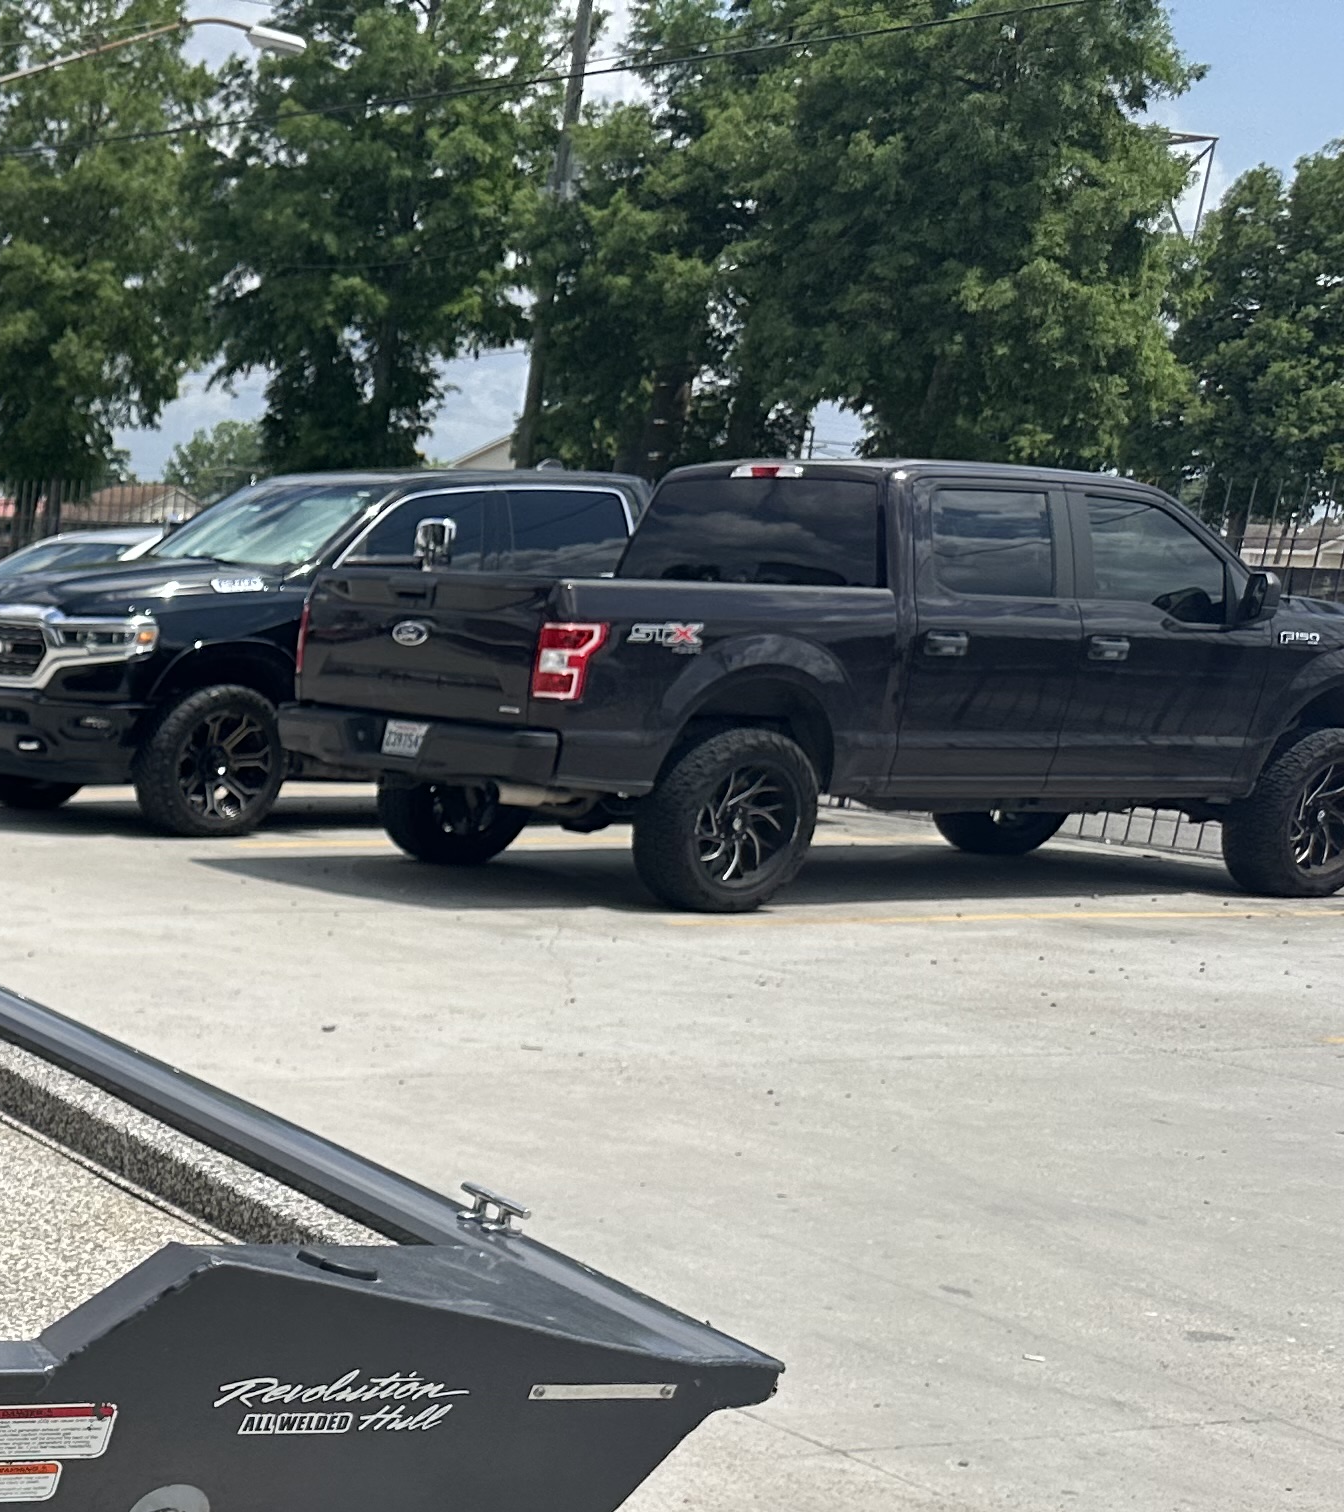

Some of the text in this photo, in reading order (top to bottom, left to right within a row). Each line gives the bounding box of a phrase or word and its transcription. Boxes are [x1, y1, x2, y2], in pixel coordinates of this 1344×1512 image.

[626, 622, 704, 647] STX
[213, 1369, 470, 1408] Revolution
[241, 1404, 453, 1432] ALL WELDED Hull
